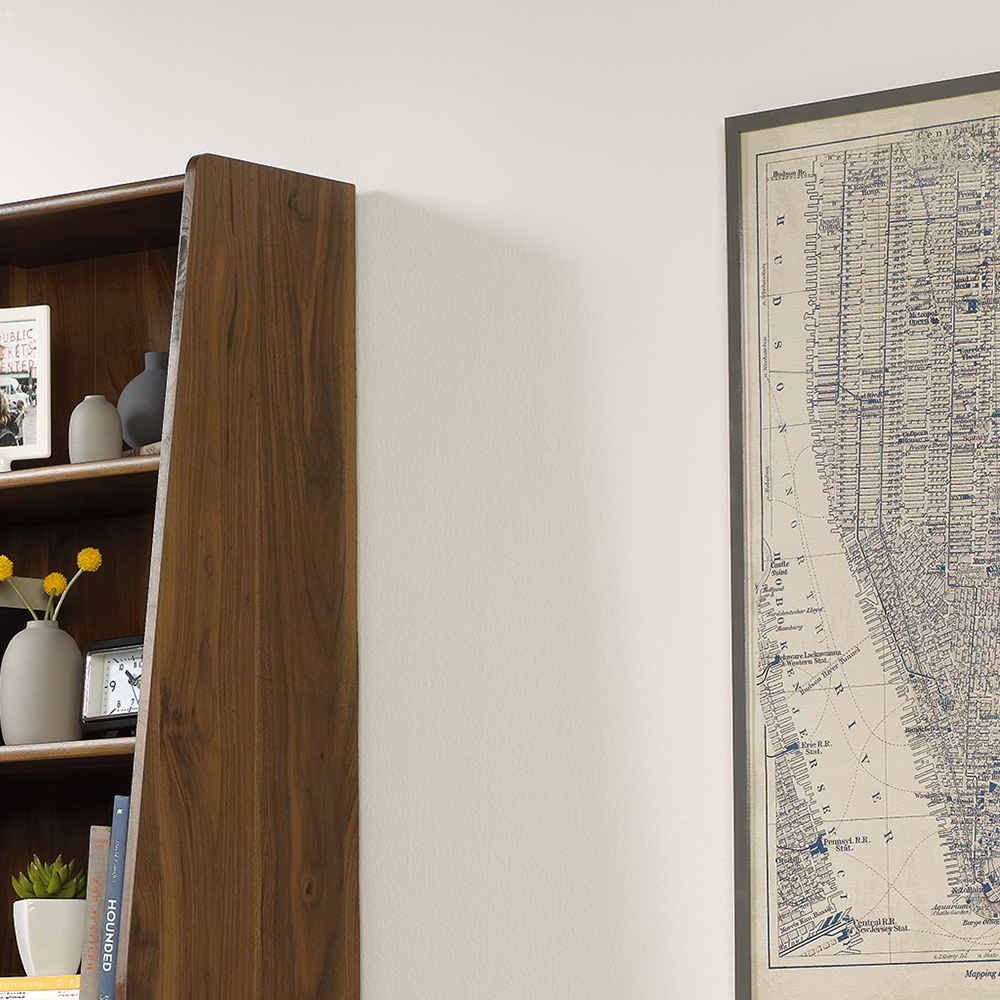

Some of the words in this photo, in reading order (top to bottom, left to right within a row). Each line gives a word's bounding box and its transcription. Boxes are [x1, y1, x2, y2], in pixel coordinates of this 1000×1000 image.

[799, 676, 823, 696] Hudson
[821, 663, 839, 679] River
[109, 680, 117, 692] 9
[116, 700, 121, 708] 8
[801, 741, 816, 749] Erie
[91, 877, 99, 902] THE
[102, 899, 117, 972] HOUNDED
[965, 969, 997, 980] Mapping
